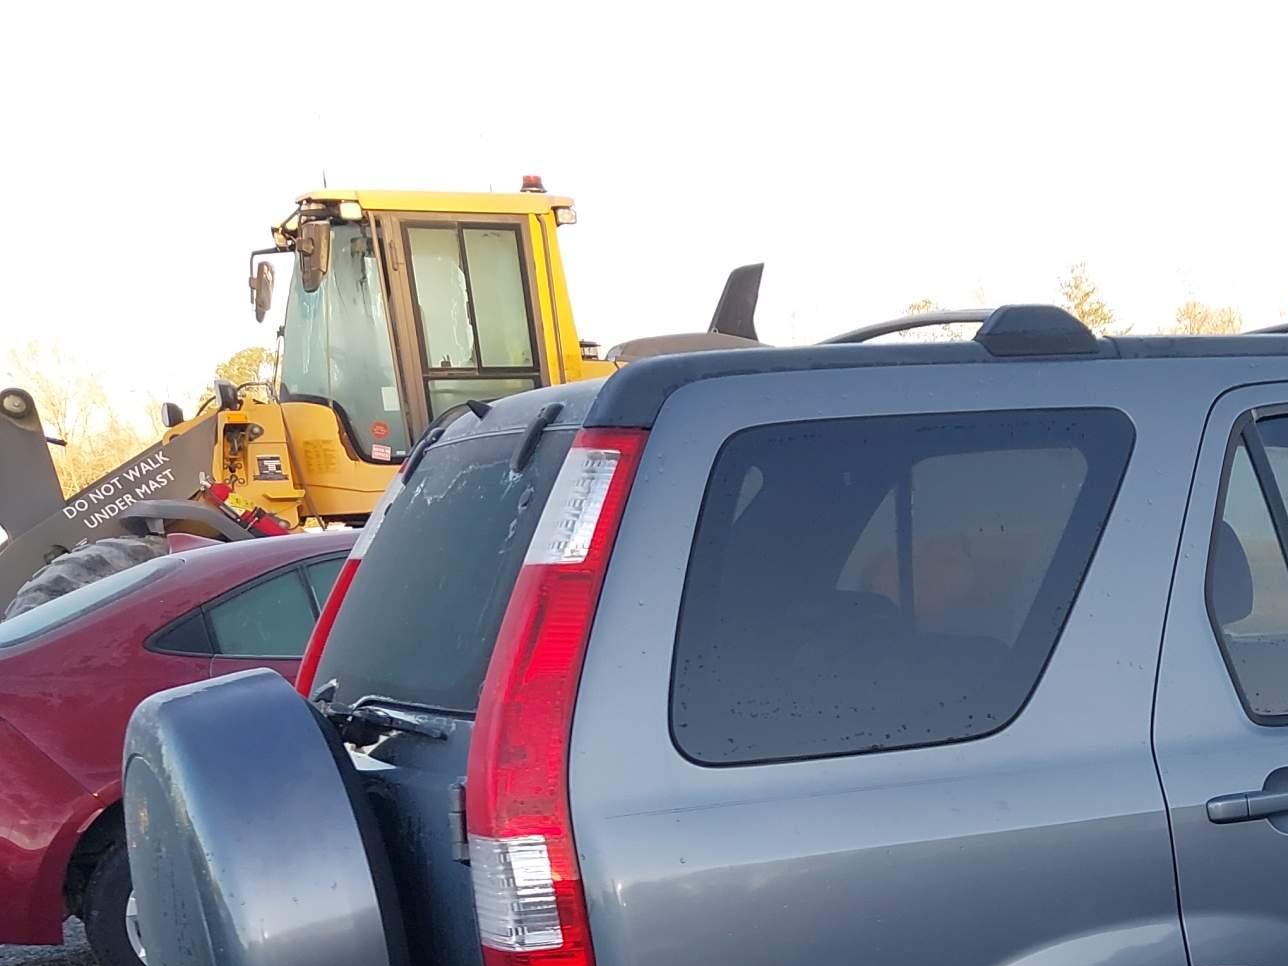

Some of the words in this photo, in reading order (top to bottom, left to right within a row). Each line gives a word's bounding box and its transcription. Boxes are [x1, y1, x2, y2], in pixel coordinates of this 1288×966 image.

[62, 499, 88, 519] DO
[88, 477, 123, 504] NOT
[122, 451, 170, 482] WALK
[83, 493, 137, 529] UNDER
[135, 468, 175, 499] MAST
